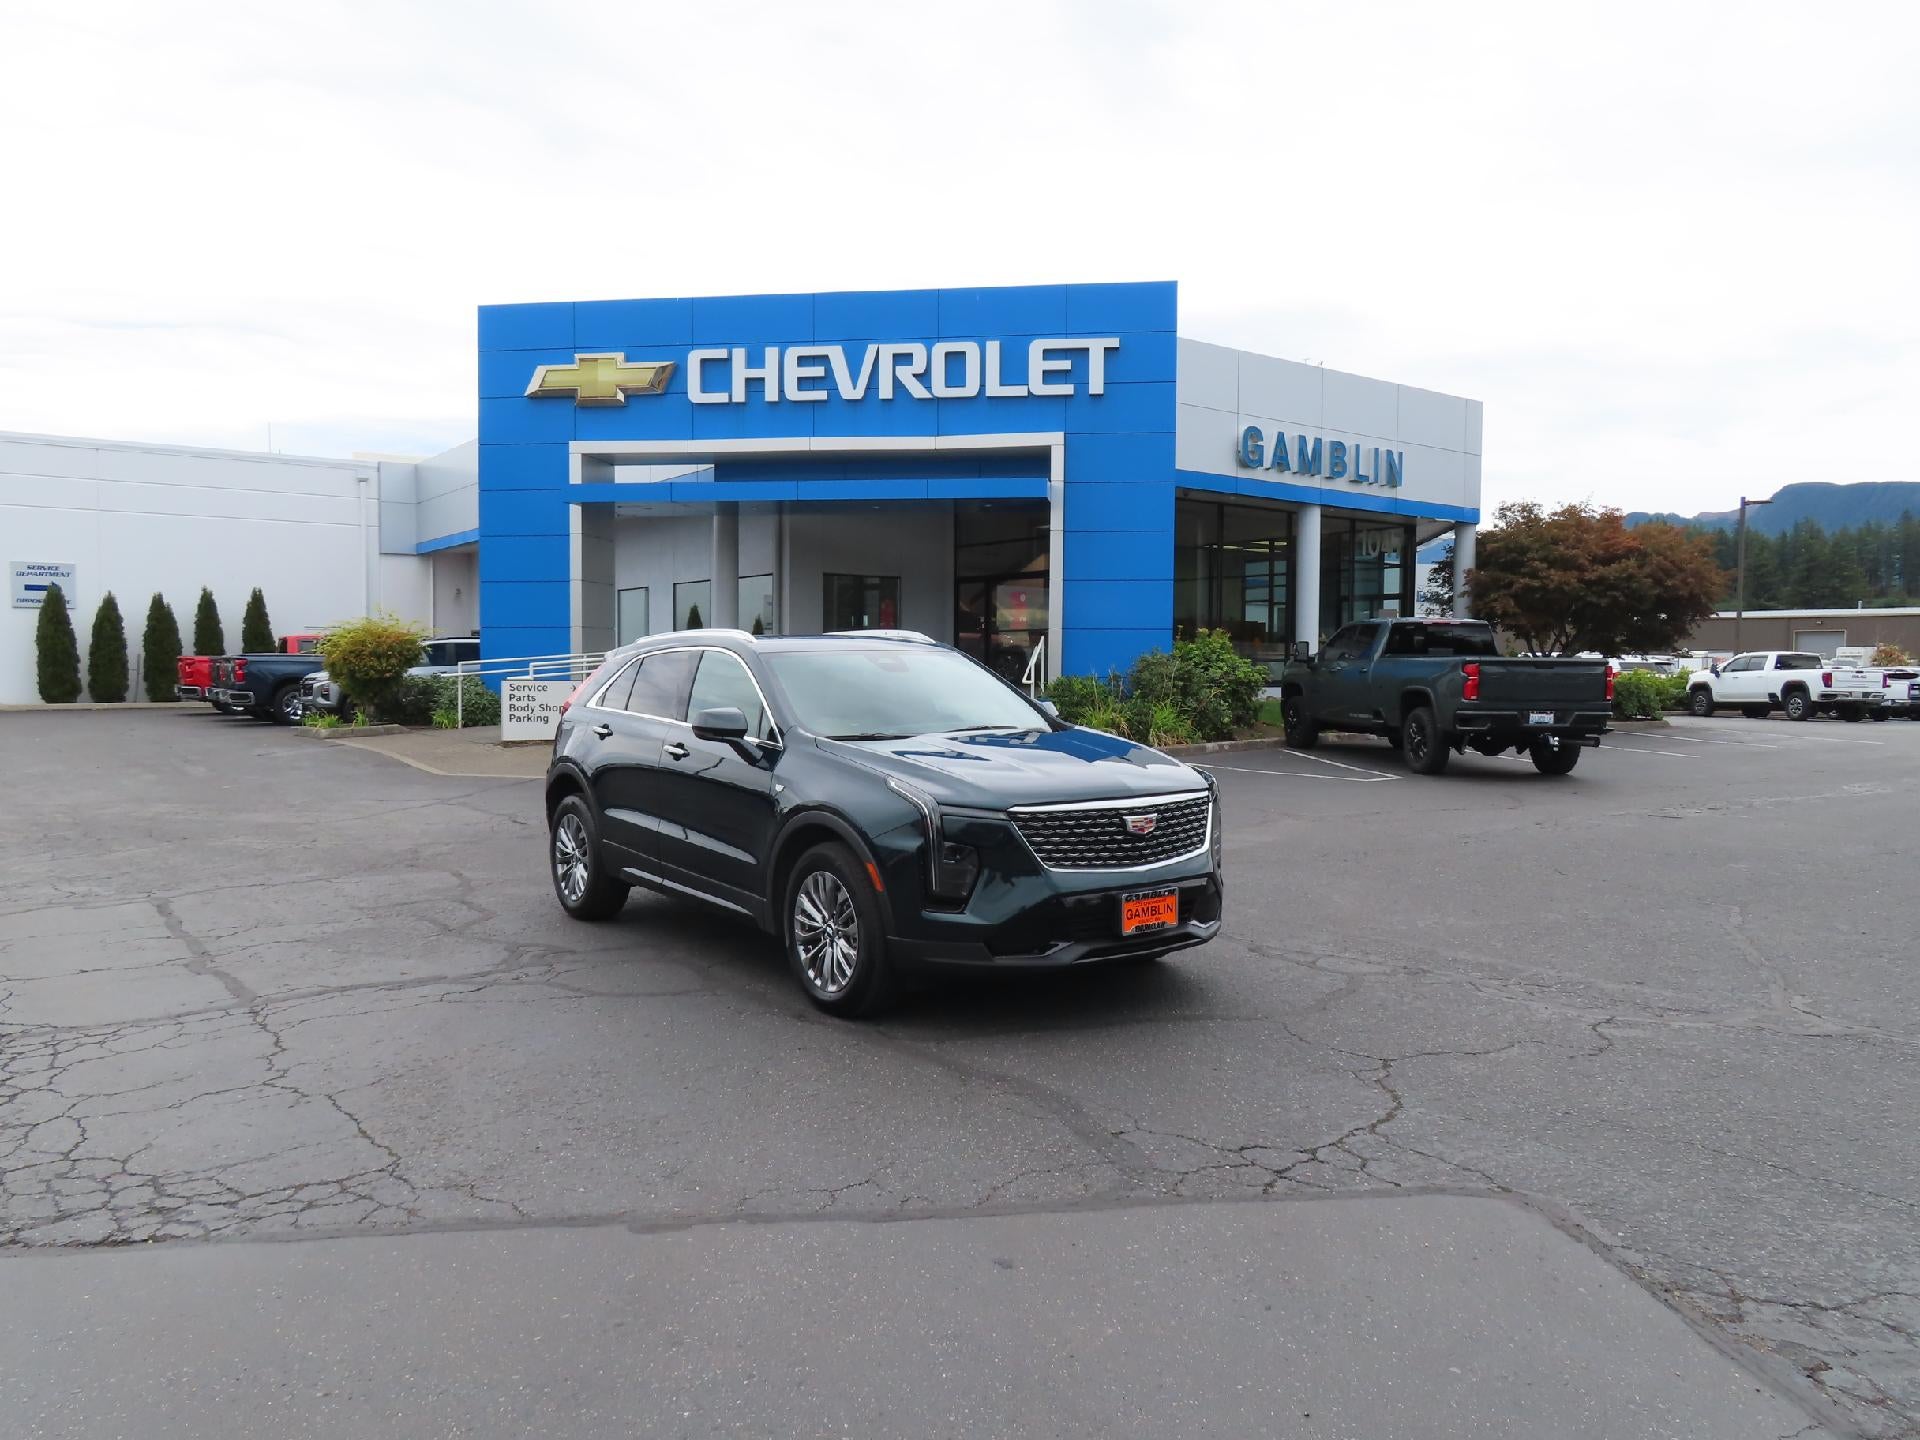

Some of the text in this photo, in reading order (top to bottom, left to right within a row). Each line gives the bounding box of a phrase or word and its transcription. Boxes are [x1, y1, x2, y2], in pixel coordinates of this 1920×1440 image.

[687, 338, 1121, 404] CHEVROLET
[1238, 425, 1403, 488] GAMBLIN
[509, 683, 548, 692] Service
[509, 693, 537, 702] Parts
[509, 703, 536, 714] Body
[509, 714, 549, 724] Parking
[1126, 903, 1174, 921] GAMBLIN
